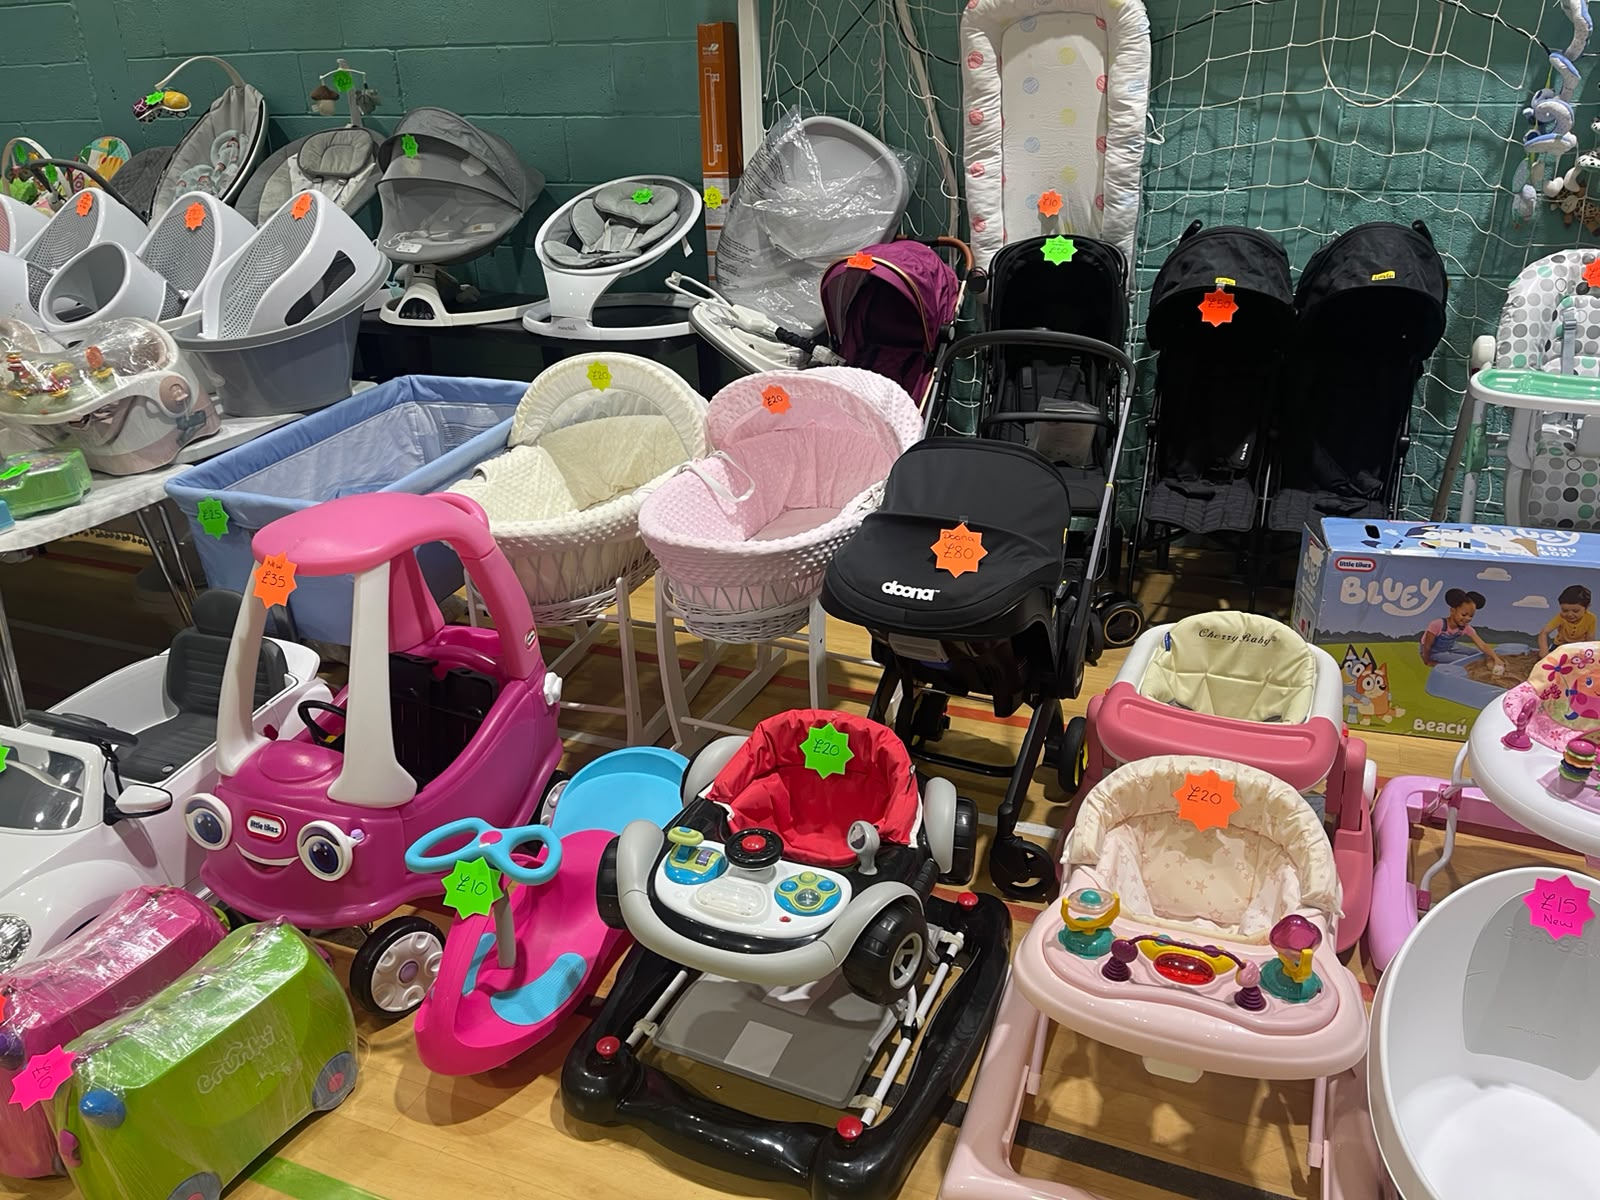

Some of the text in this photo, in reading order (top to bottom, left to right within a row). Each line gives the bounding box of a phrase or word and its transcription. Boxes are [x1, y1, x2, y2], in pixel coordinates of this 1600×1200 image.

[1043, 196, 1059, 207] £10
[1208, 297, 1231, 309] £50
[765, 395, 783, 406] £20
[942, 531, 975, 542] Doona
[943, 542, 975, 559] £80
[261, 570, 286, 588] £35
[881, 580, 935, 602] doona
[1340, 576, 1443, 617] BLUEY
[1198, 628, 1239, 645] Cherry
[813, 738, 840, 756] £20
[1186, 784, 1222, 805] £20
[456, 872, 488, 896] £10
[1541, 891, 1578, 915] £15
[1543, 913, 1574, 929] New
[31, 1059, 53, 1090] £10
